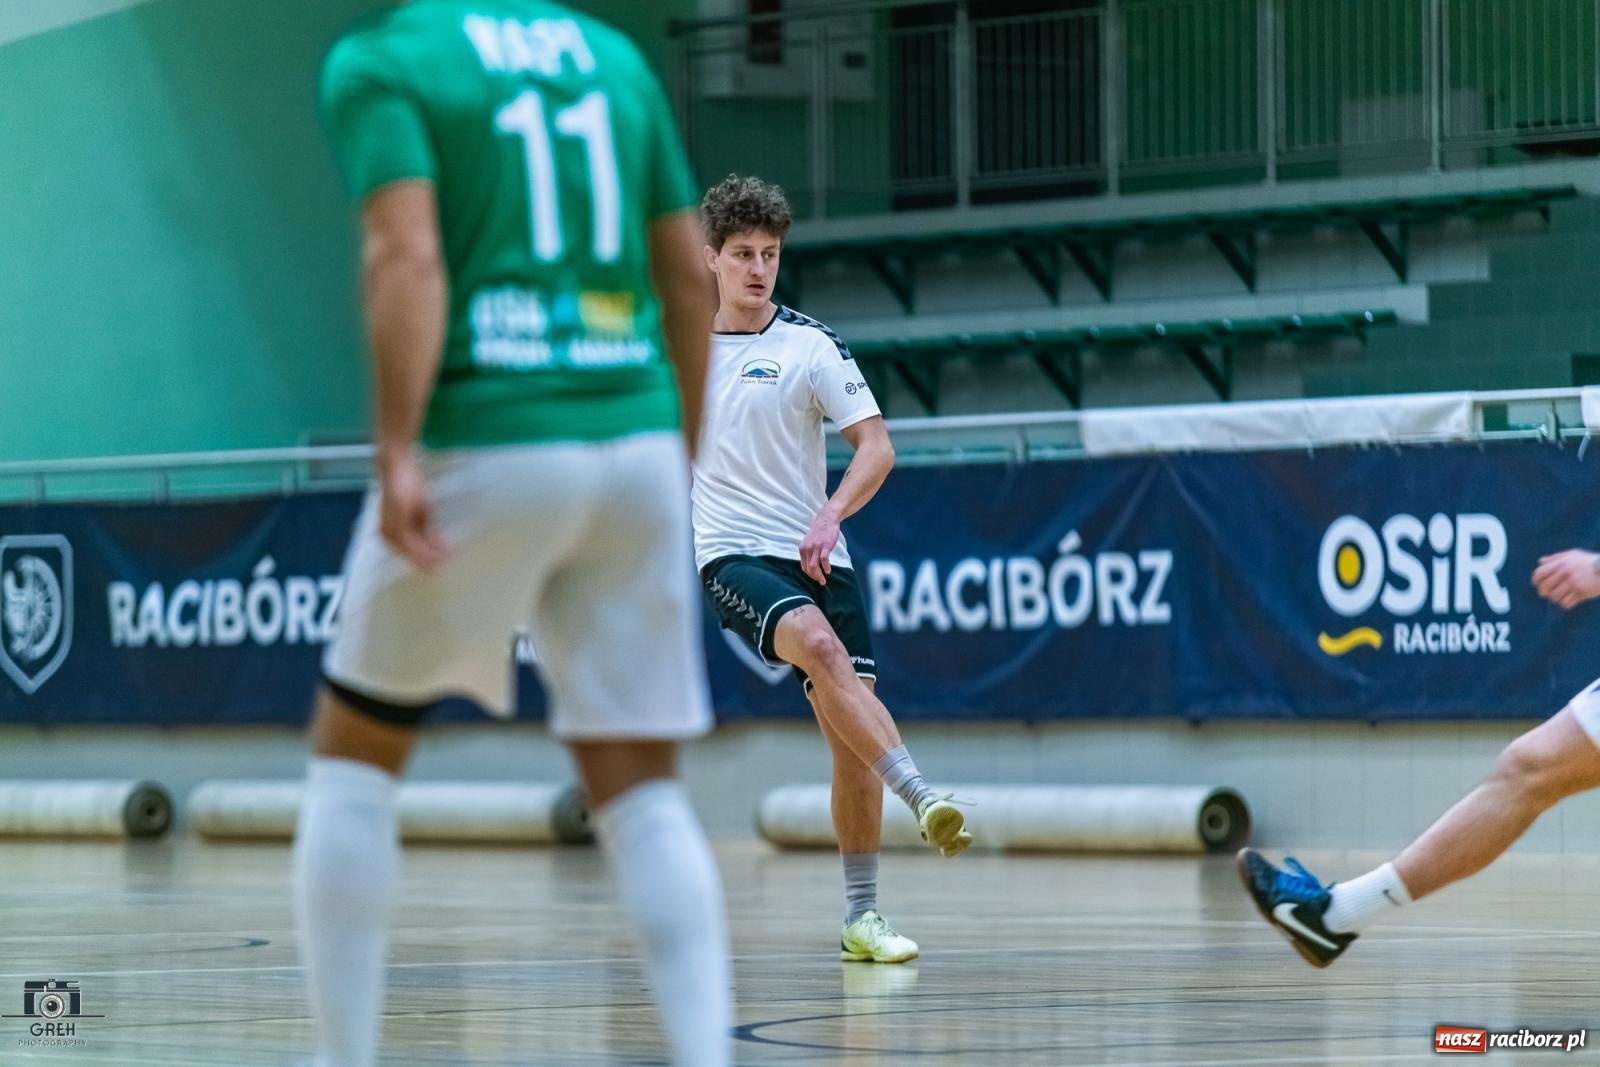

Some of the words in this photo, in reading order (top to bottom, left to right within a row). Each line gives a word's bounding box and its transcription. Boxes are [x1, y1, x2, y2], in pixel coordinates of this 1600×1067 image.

[495, 89, 621, 263] 11
[107, 556, 344, 648] RACIBÓRZ
[868, 529, 1173, 632] RACIBÓRZ
[1318, 512, 1511, 617] OSiR
[1393, 614, 1511, 653] RACIBÓRZ
